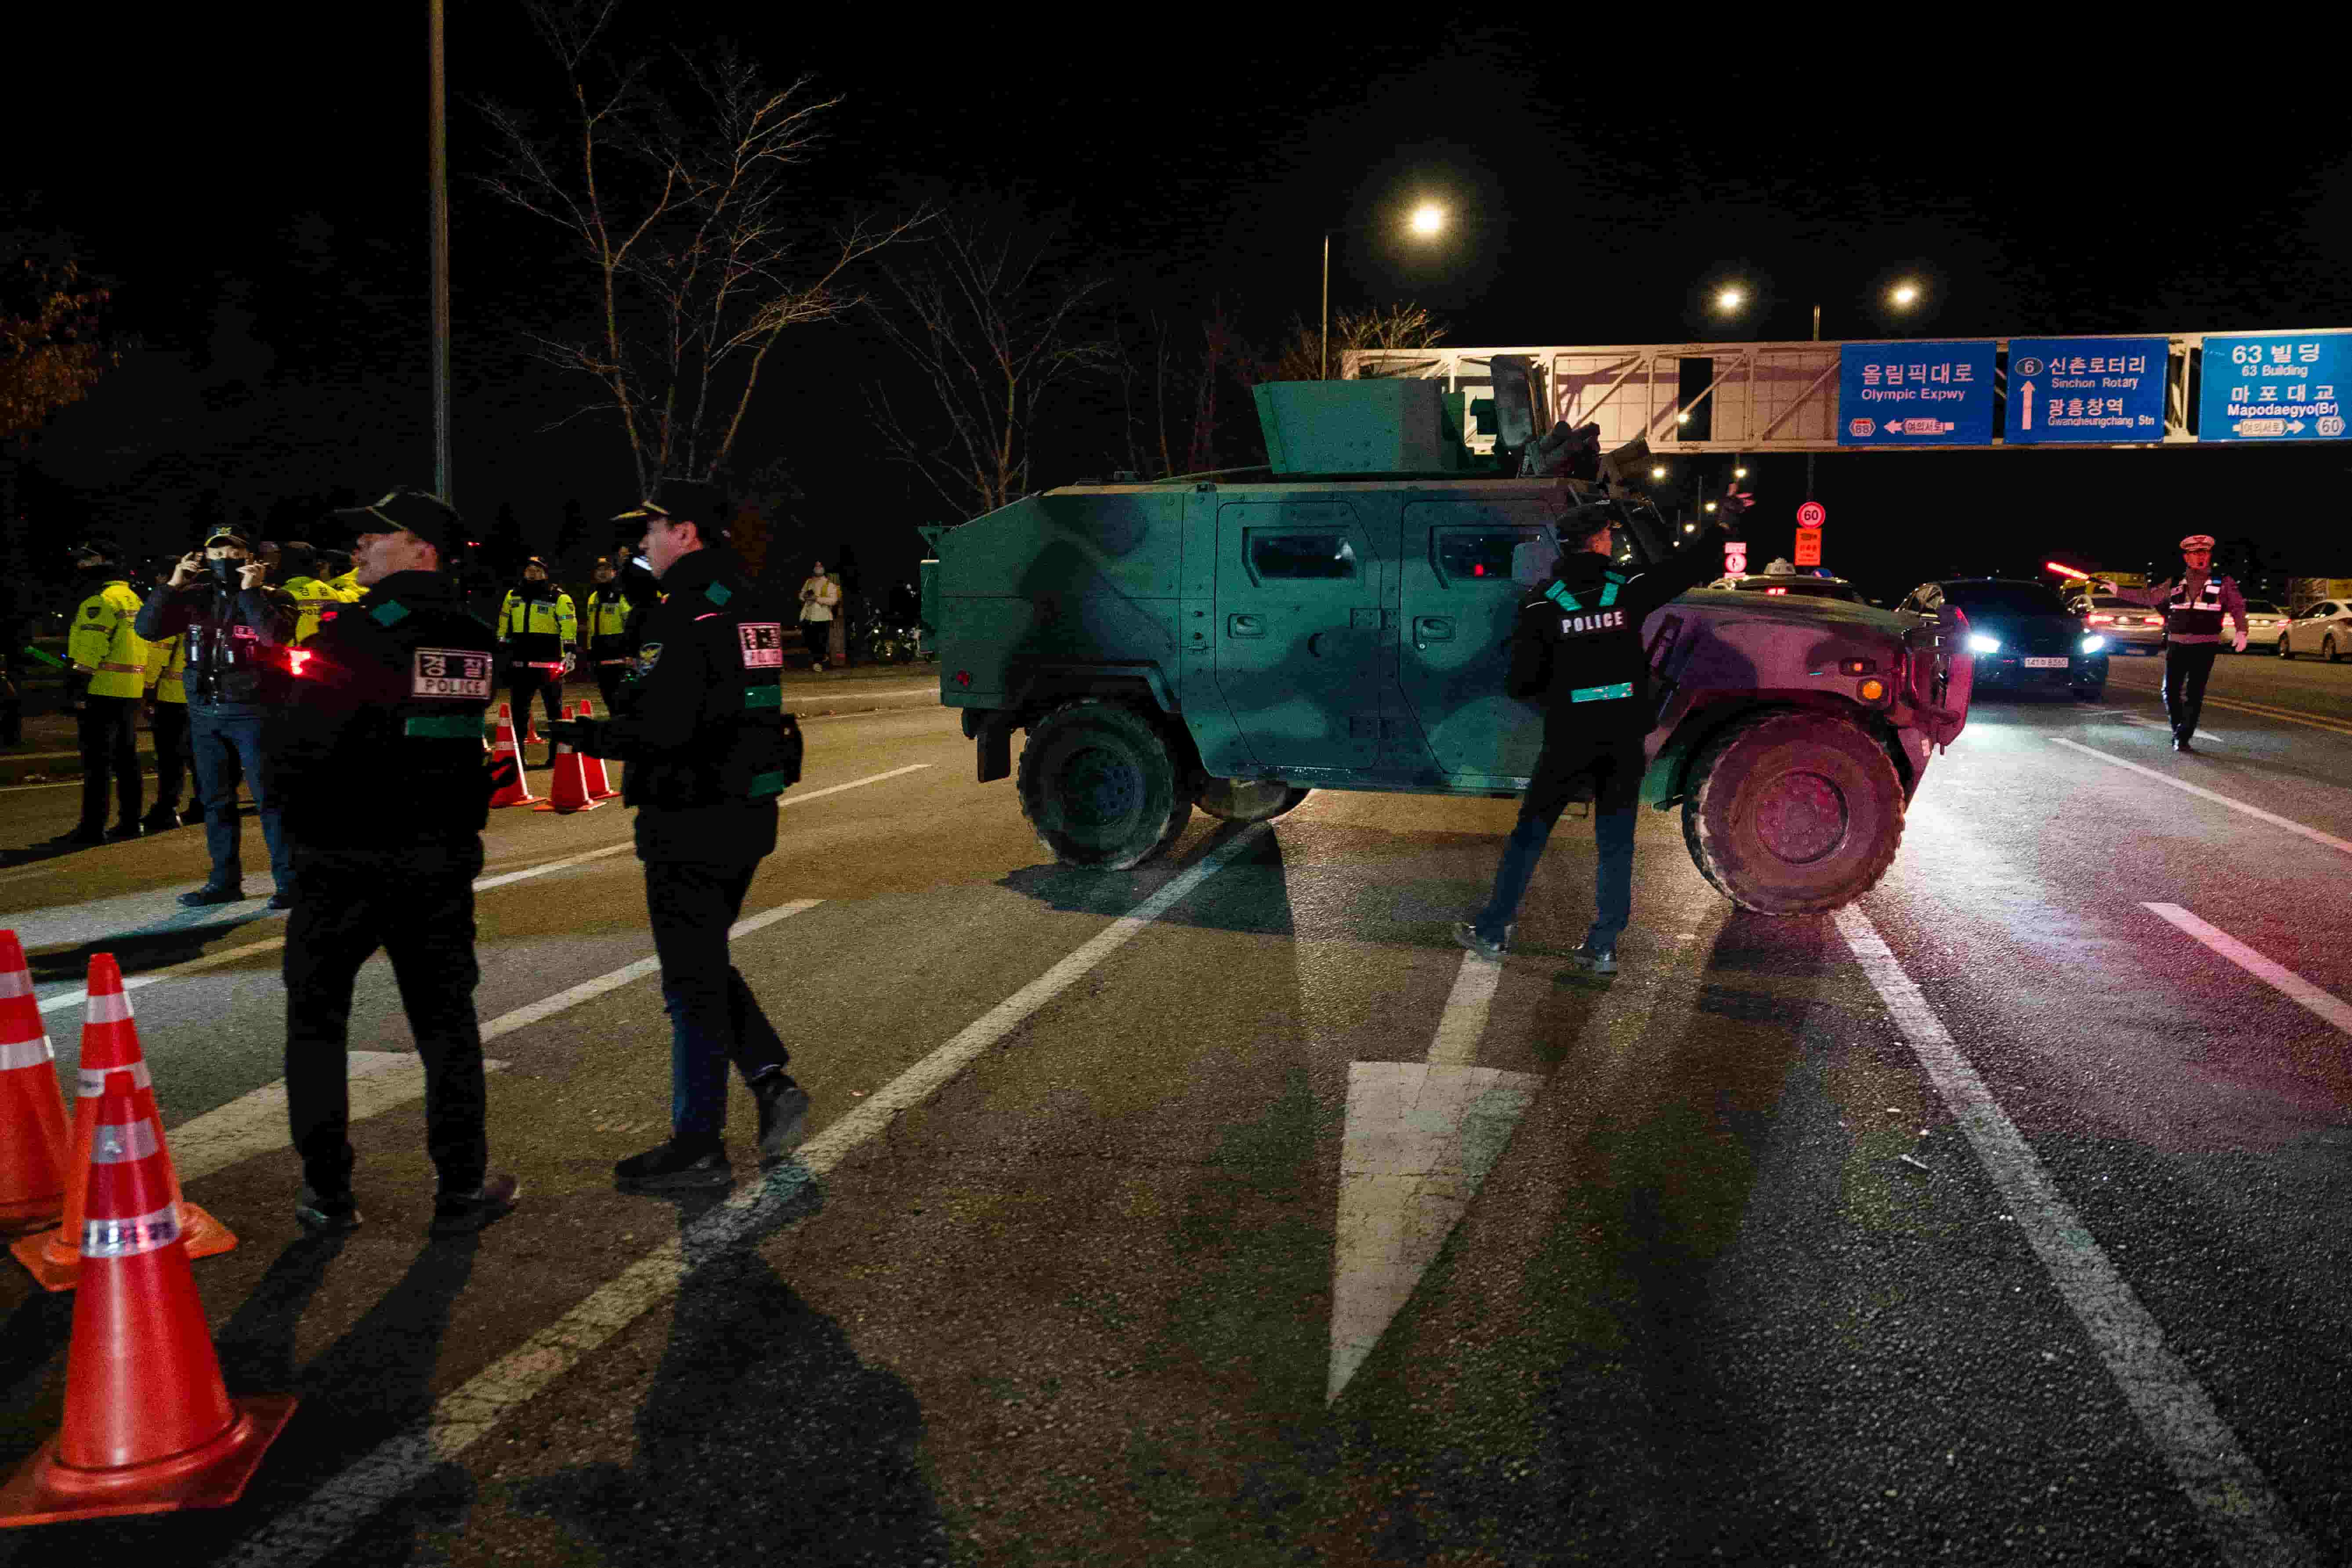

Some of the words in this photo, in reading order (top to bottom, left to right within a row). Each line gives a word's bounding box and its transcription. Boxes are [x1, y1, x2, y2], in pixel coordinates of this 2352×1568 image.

[2233, 345, 2262, 363] 63
[2271, 344, 2319, 363] 빌딩
[2025, 360, 2034, 373] 6
[2049, 355, 2146, 374] 신촌로터리
[2242, 365, 2257, 377] 63
[2262, 365, 2308, 377] Building
[1862, 363, 1974, 385] 올림픽대로
[2052, 378, 2095, 387] Sinchon
[2102, 377, 2138, 390] Rotary
[1862, 388, 1916, 402] Olympic
[1921, 387, 1965, 401] Expwy
[2048, 398, 2123, 416] 광흥창역
[2227, 402, 2338, 417] Mapodaegyo(Br)
[2139, 414, 2154, 425] Stn
[2323, 420, 2339, 433] 60
[1804, 510, 1818, 521] 60
[1562, 611, 1624, 633] POLICE
[425, 679, 482, 694] POLICE
